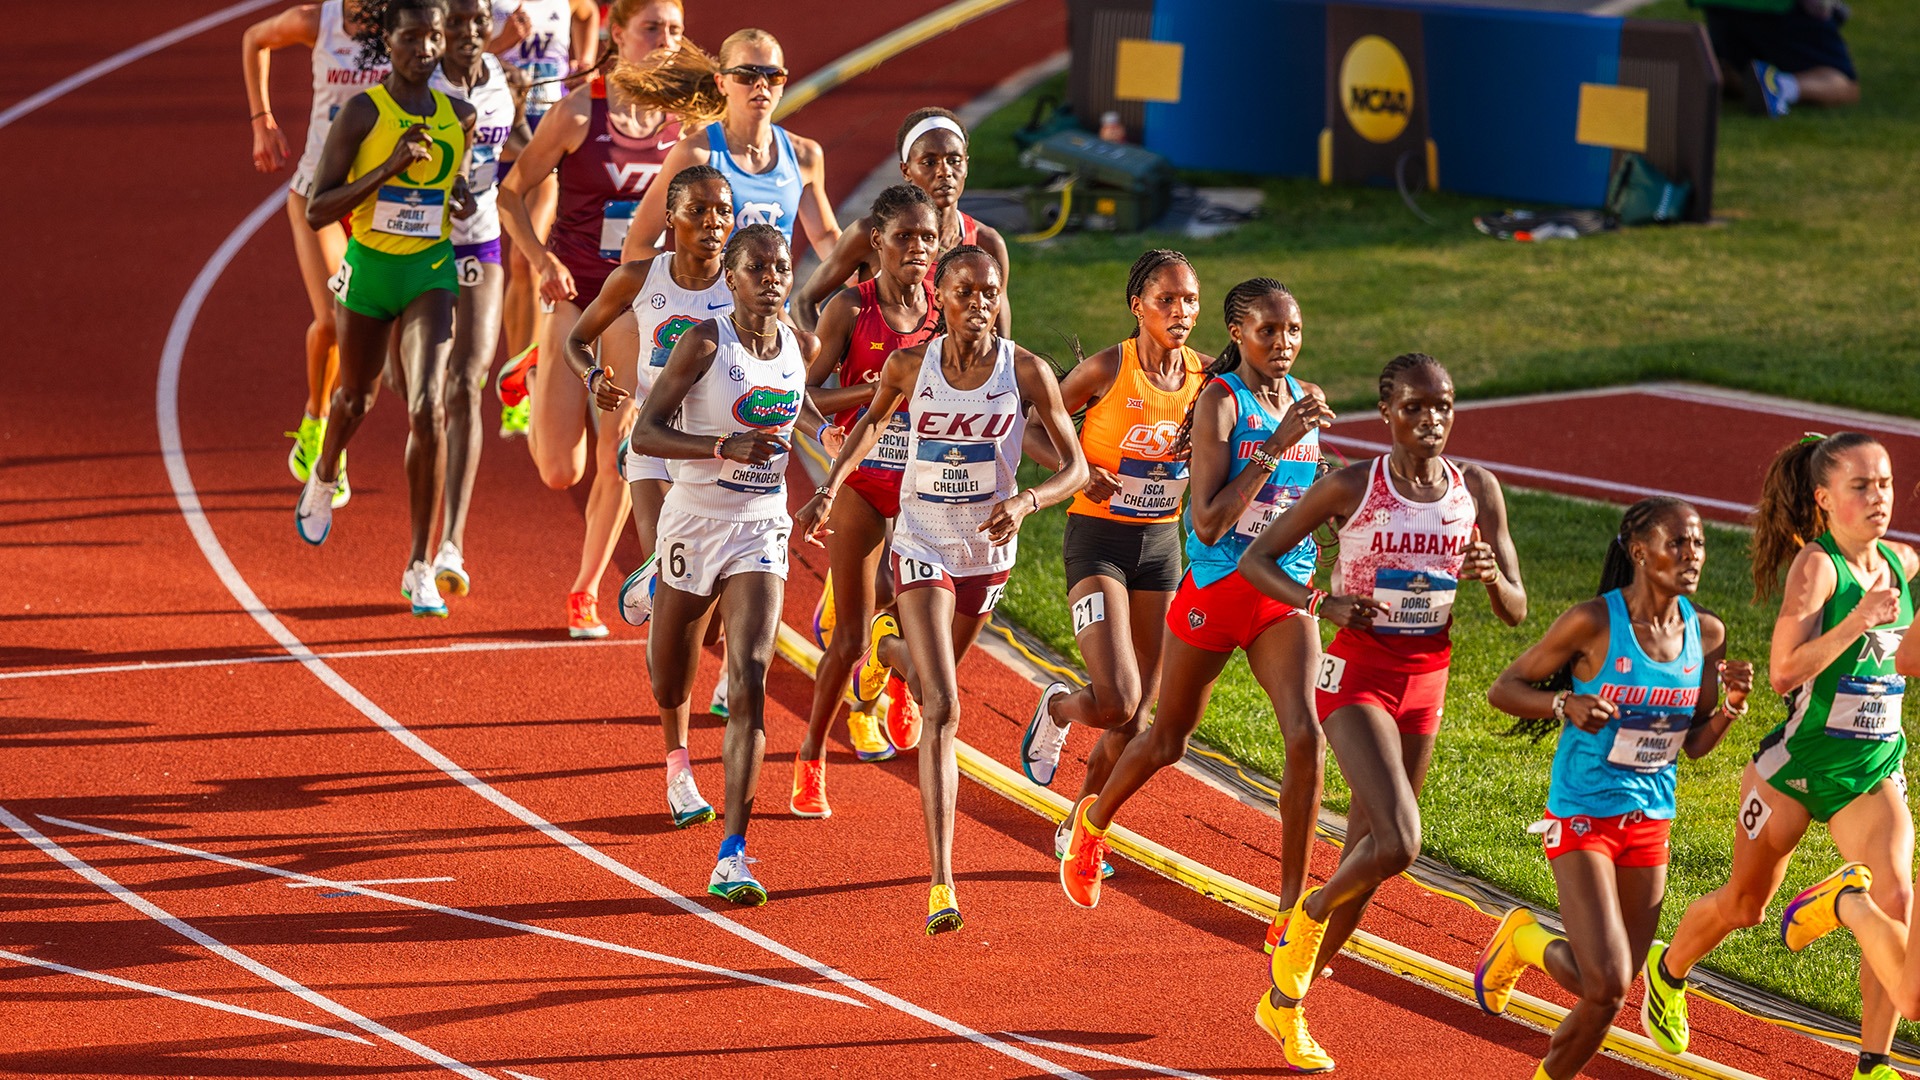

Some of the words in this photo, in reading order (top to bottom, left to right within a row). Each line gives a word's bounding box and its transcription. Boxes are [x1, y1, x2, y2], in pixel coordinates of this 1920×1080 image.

[603, 161, 663, 193] VT
[917, 411, 1016, 438] EKU
[732, 469, 781, 484] CHEPKOECH
[942, 468, 969, 480] EDNA
[933, 480, 979, 493] CHELULEI
[1143, 484, 1165, 495] ISCA
[1123, 493, 1177, 509] CHELANGAT
[669, 542, 687, 579] 6
[1401, 597, 1432, 609] DORIS
[1075, 597, 1093, 632] 21
[1387, 611, 1440, 624] LEMNGOLE
[1852, 715, 1887, 729] KEELER
[1743, 797, 1763, 831] 8
